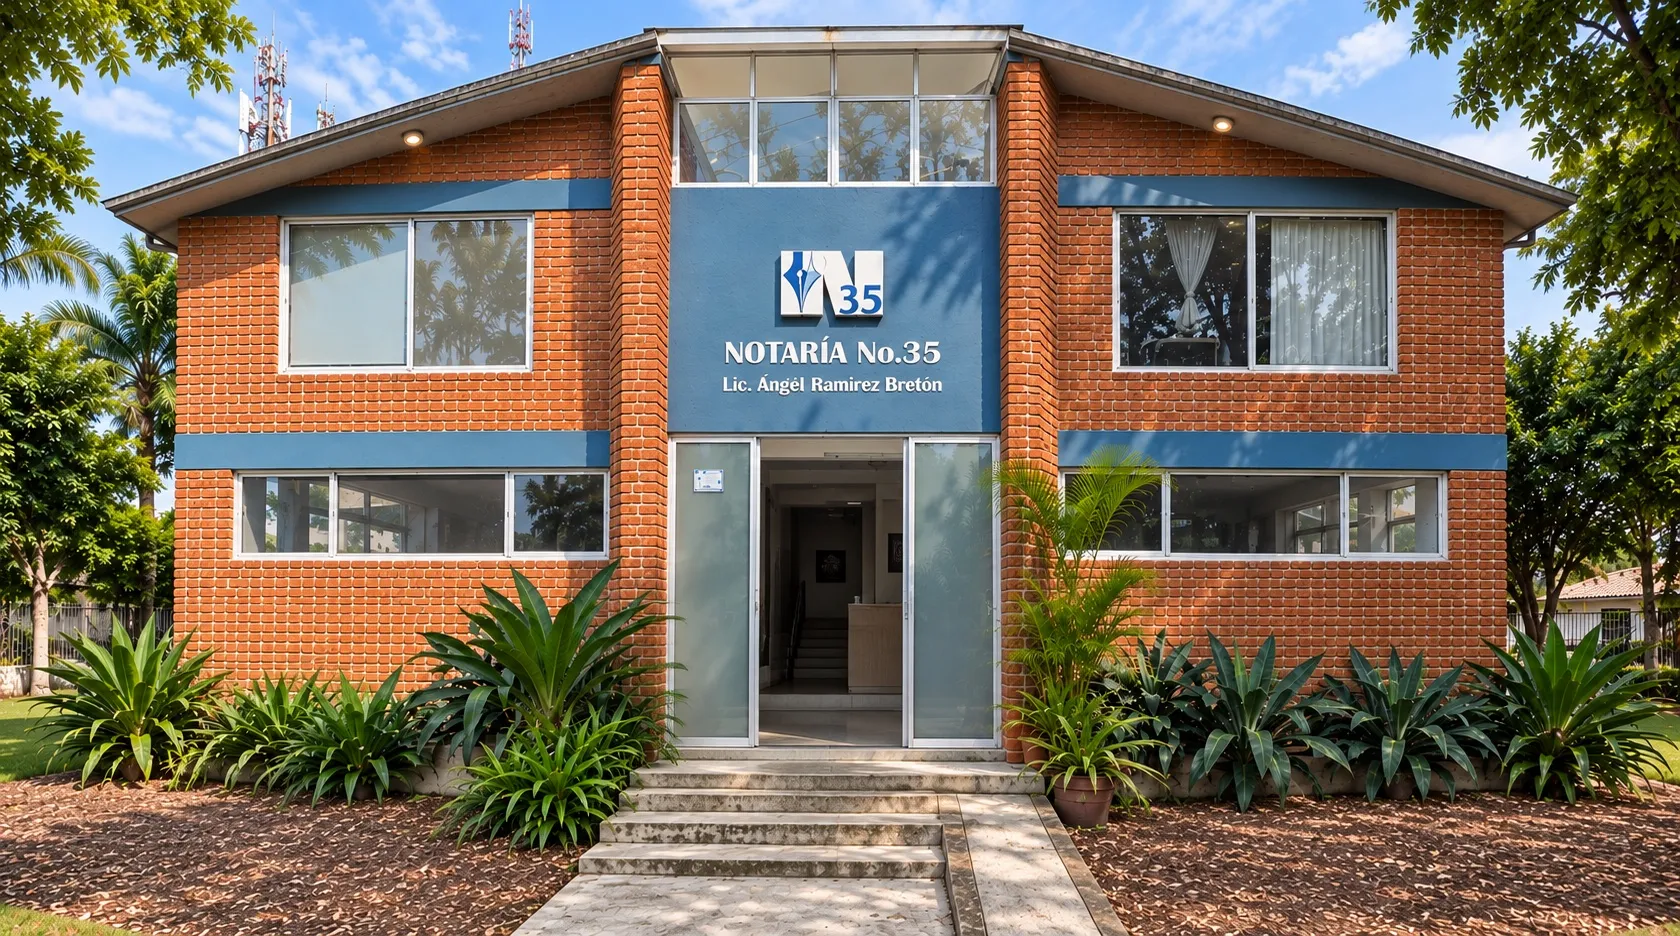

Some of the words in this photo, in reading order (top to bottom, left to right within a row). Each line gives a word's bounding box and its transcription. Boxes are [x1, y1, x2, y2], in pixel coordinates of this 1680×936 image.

[839, 284, 882, 314] 35
[724, 336, 848, 364] NOTARÍA
[857, 340, 942, 364] No.35
[723, 376, 752, 392] Lic.
[811, 376, 880, 392] Ramirez
[885, 375, 943, 392] Bretón
